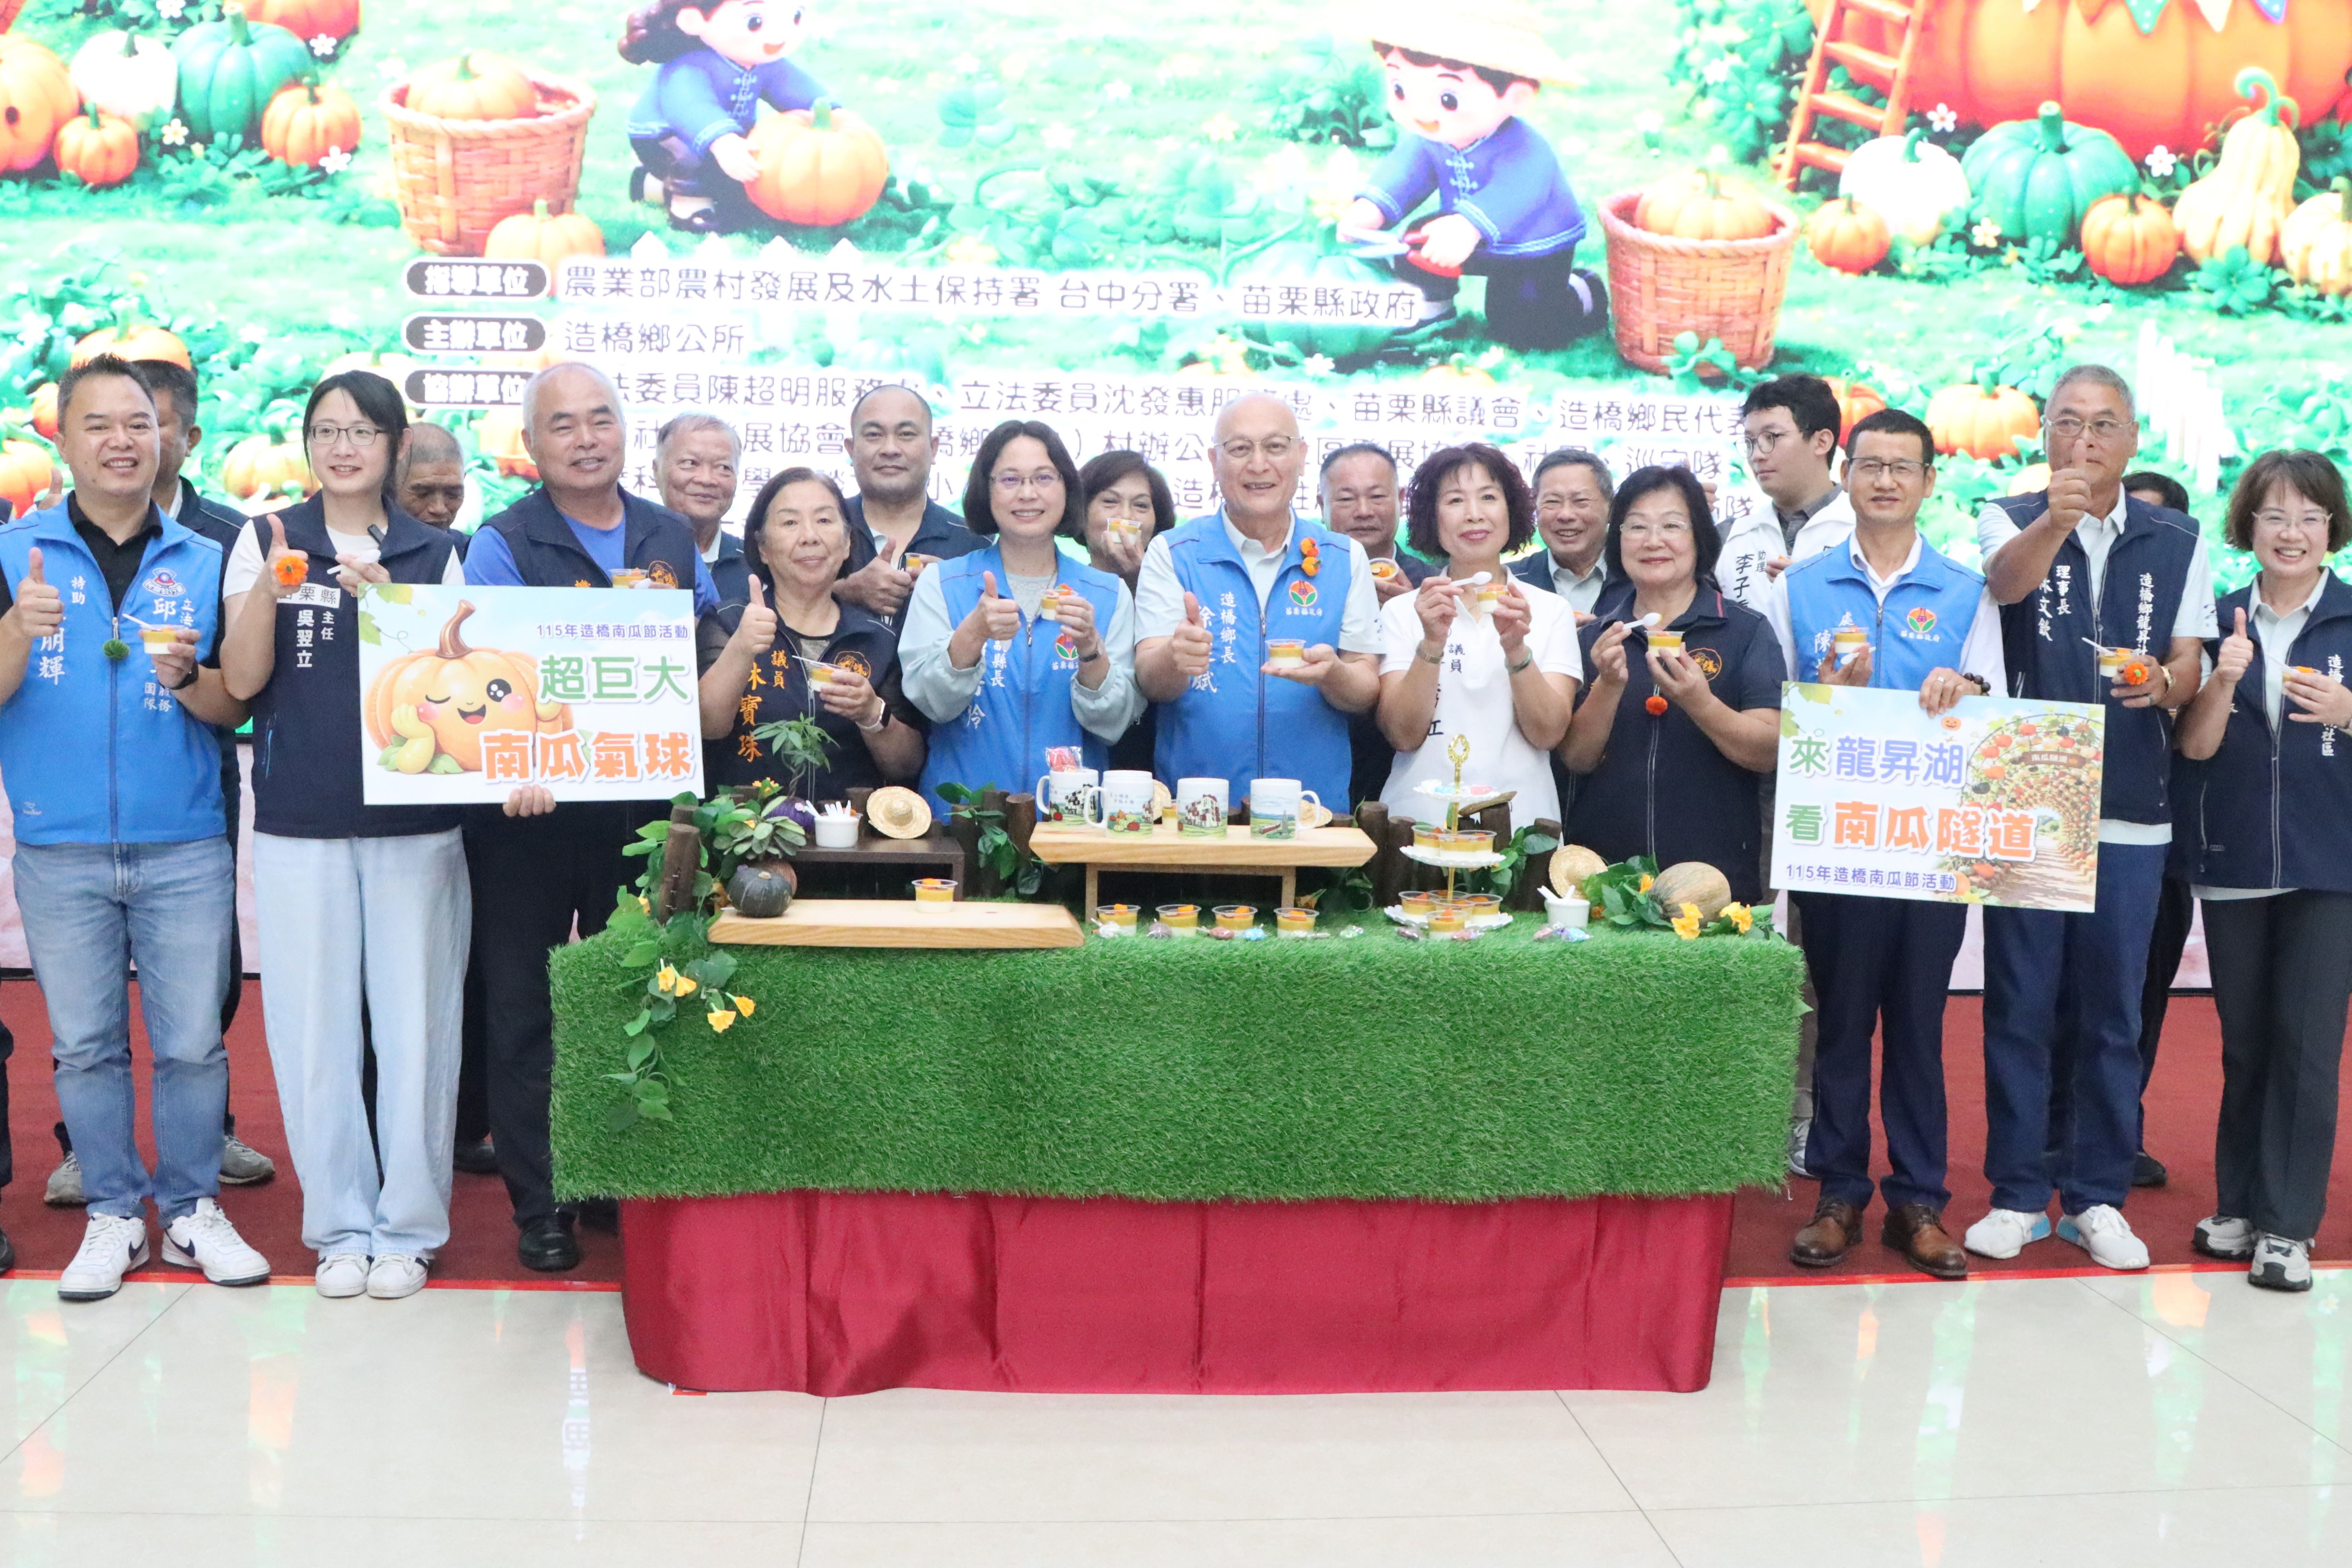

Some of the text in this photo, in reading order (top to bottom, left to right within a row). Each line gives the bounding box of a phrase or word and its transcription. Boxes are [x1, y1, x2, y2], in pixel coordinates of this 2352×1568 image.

[565, 266, 1040, 309] 農業部農村發展及水土保持署
[1058, 278, 1420, 321] 台中分署、苗栗縣政府
[564, 321, 744, 354] 造橋鄉公所
[1755, 550, 1766, 572] 助理
[71, 576, 86, 605] 特助
[2056, 565, 2071, 615] 理事長
[296, 609, 315, 668] 吳翌立
[321, 611, 335, 640] 主任
[537, 624, 689, 639] 115年造橋南瓜節活動
[1220, 591, 1237, 664] 造橋鄉長
[38, 616, 65, 685] 朋輝
[771, 649, 789, 689] 議員
[1447, 643, 1465, 673] 議員
[540, 654, 689, 700] 超巨大
[483, 732, 692, 779] 南瓜氣球
[1789, 736, 1964, 785] 來龍昇湖
[1786, 801, 2034, 858] 看南瓜隧道
[1786, 864, 1957, 891] 115年造橋南瓜節活動
